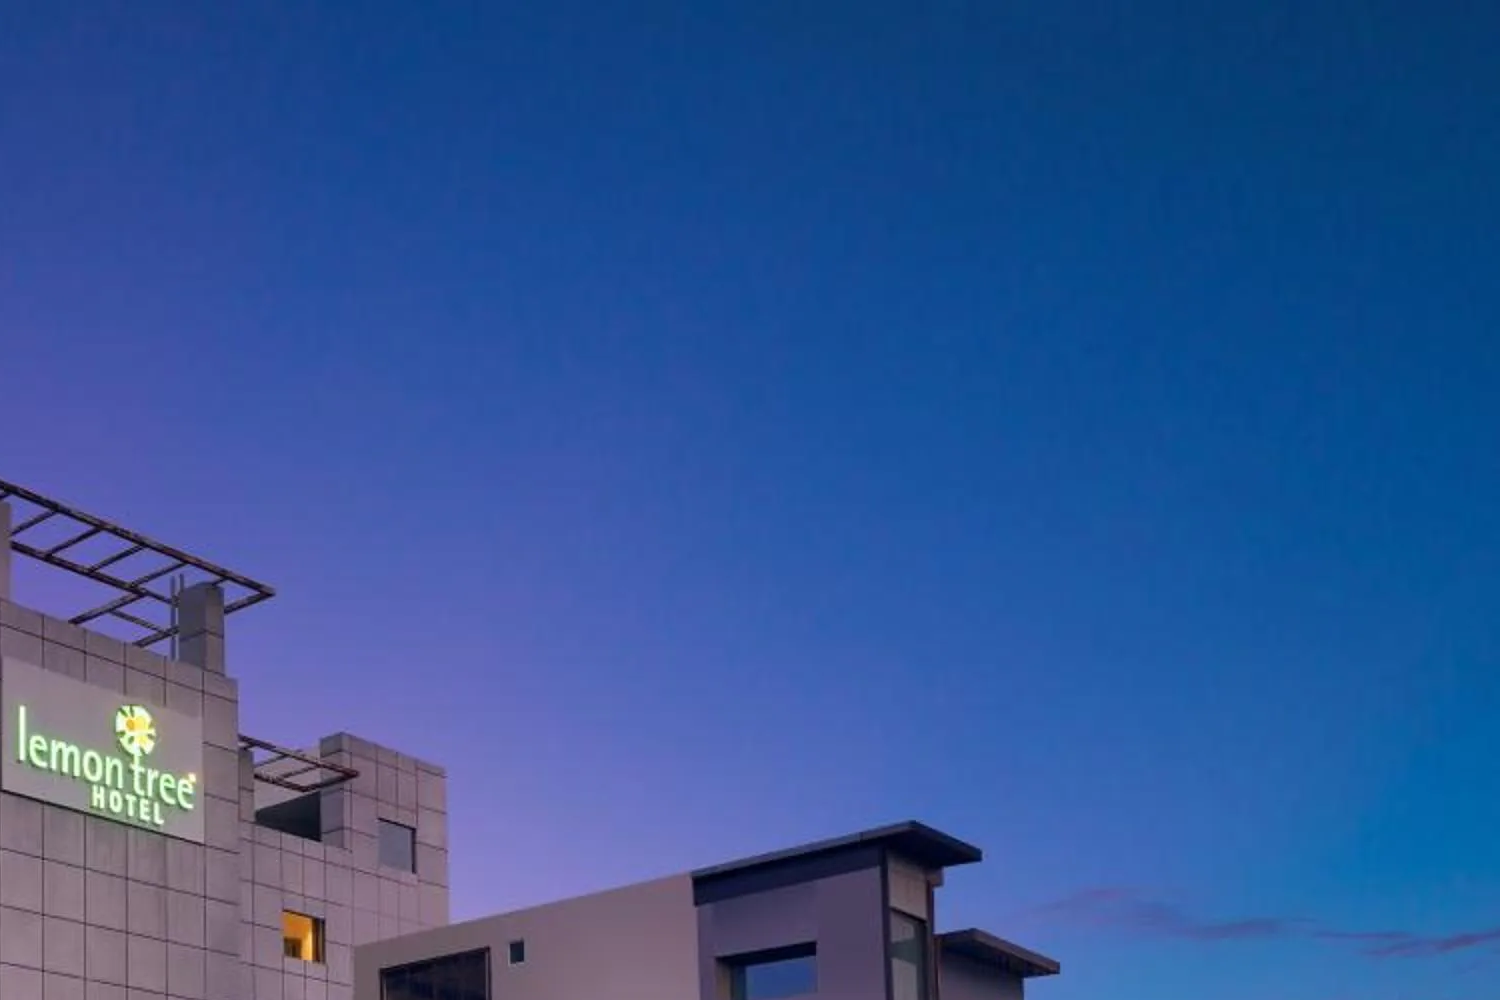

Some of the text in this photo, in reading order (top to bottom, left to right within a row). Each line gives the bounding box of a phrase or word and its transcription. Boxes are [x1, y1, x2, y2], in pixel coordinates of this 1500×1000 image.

[19, 705, 195, 810] lemon tree
[91, 784, 165, 826] HOTEL
